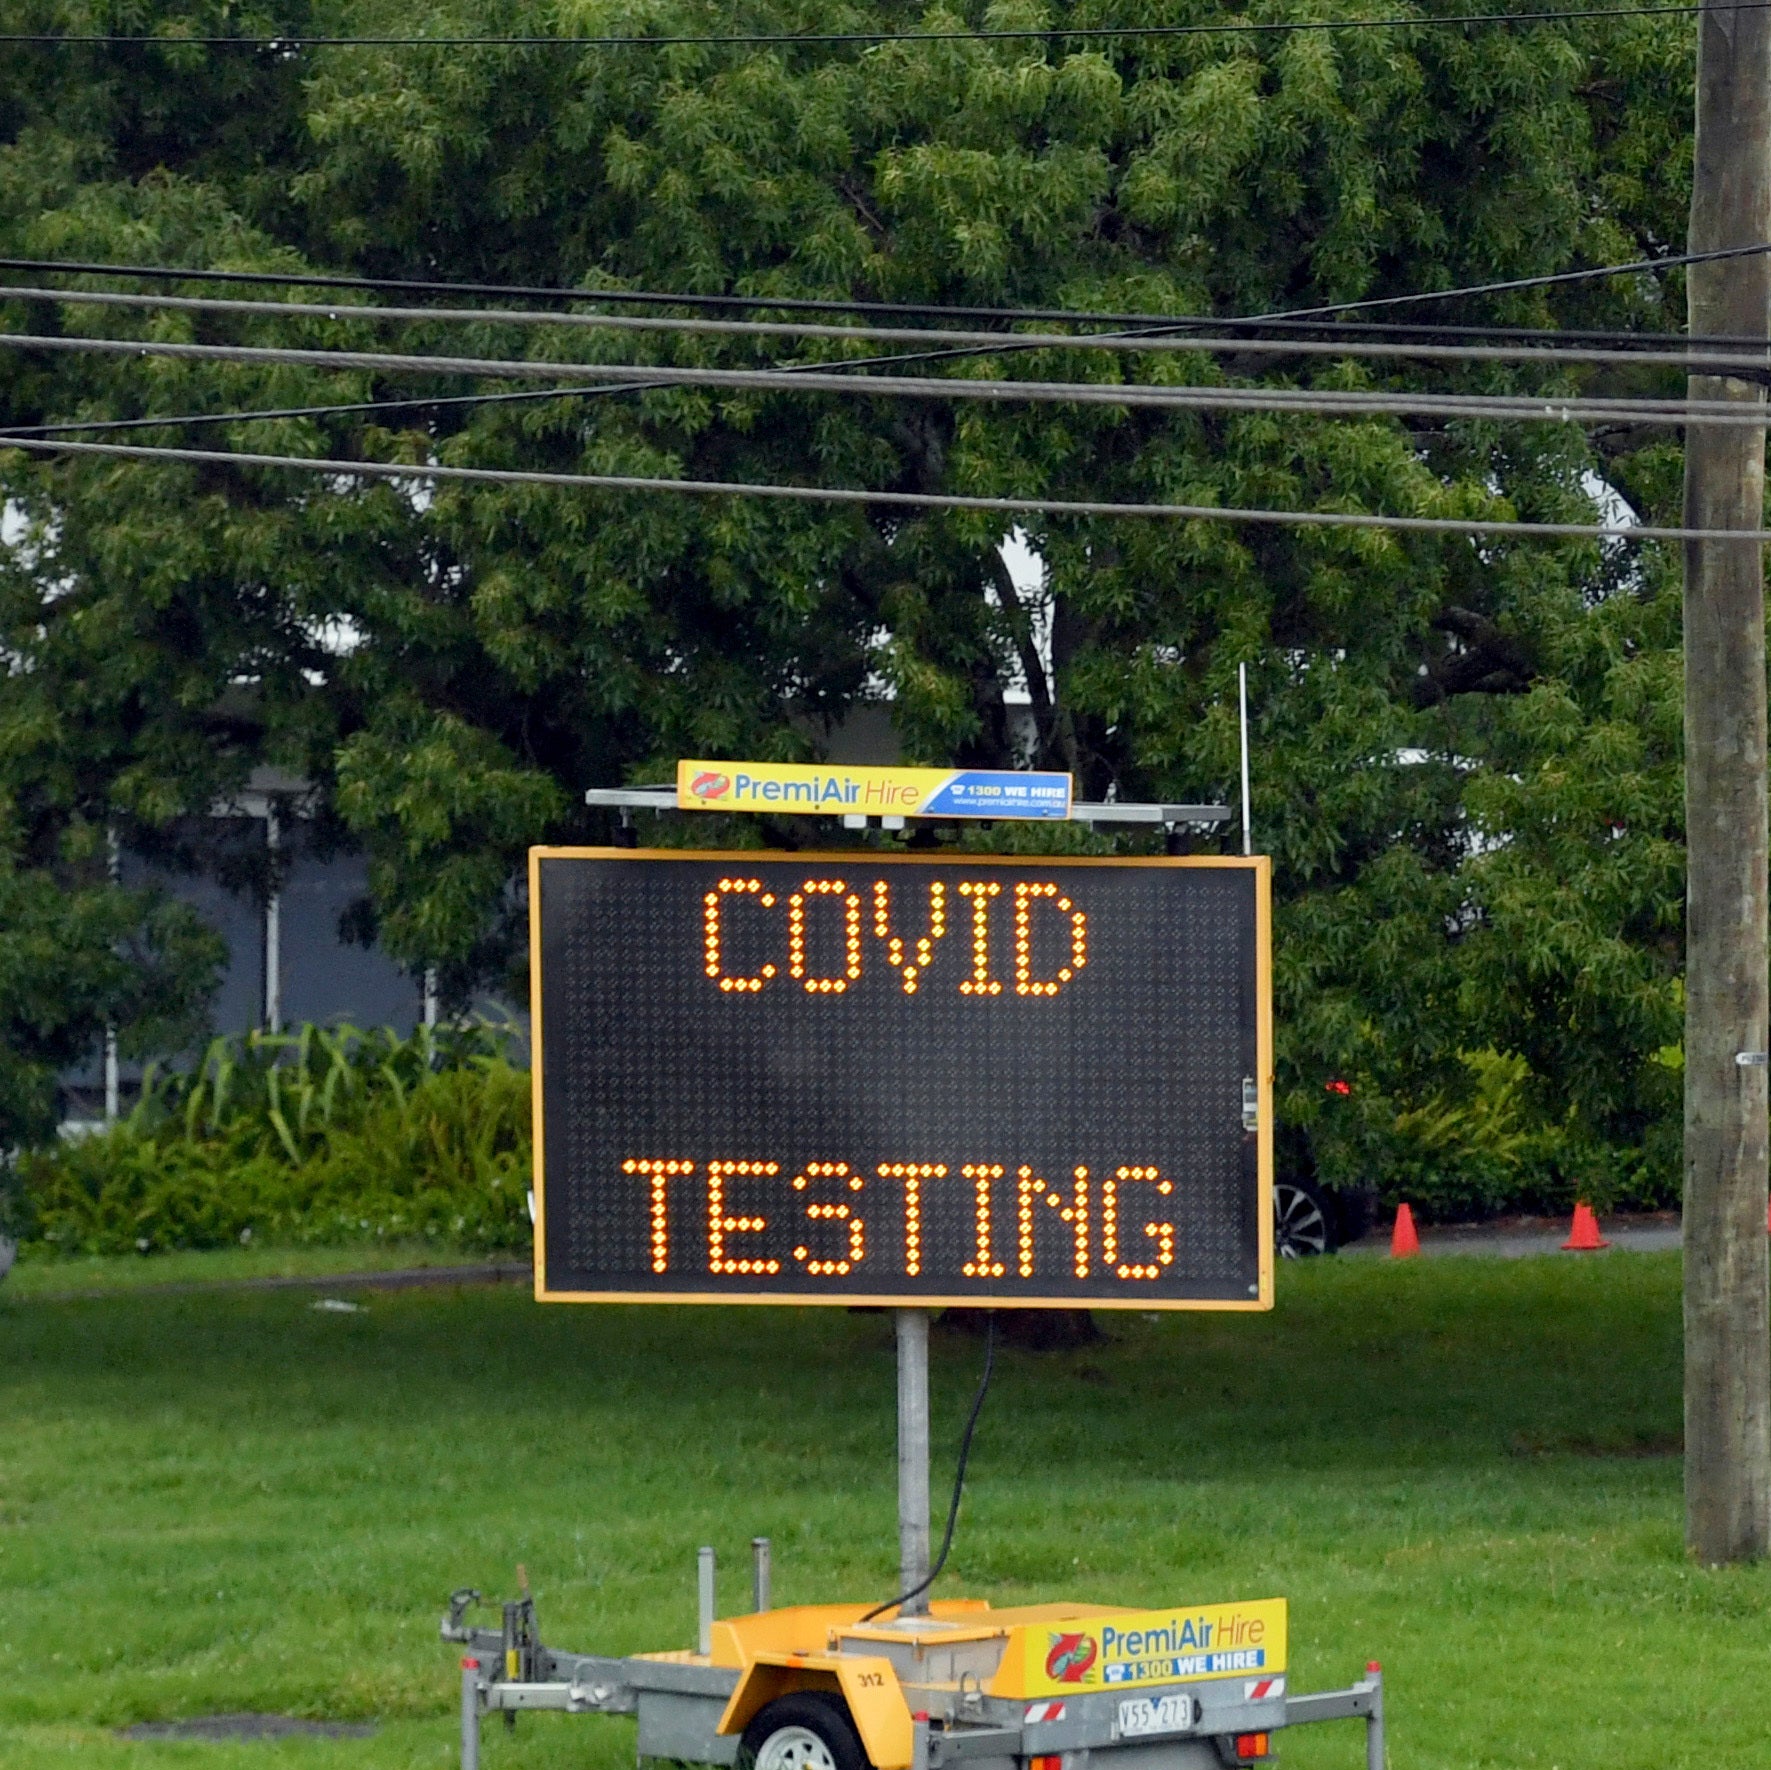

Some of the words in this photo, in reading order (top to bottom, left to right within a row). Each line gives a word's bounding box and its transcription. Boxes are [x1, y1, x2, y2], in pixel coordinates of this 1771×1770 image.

[734, 773, 860, 804] PremiAir
[865, 779, 920, 805] Hire
[968, 786, 1001, 796] 1300
[1004, 786, 1027, 797] WE
[1030, 787, 1066, 798] HIRE
[703, 877, 1089, 997] COVID
[621, 1158, 1175, 1281] TESTING
[1102, 1616, 1214, 1658] PremiAir
[1216, 1614, 1266, 1647] Hire
[857, 1672, 885, 1688] 312
[1129, 1658, 1173, 1680] 1300
[1176, 1655, 1206, 1676] WE
[1212, 1650, 1258, 1671] HIRE
